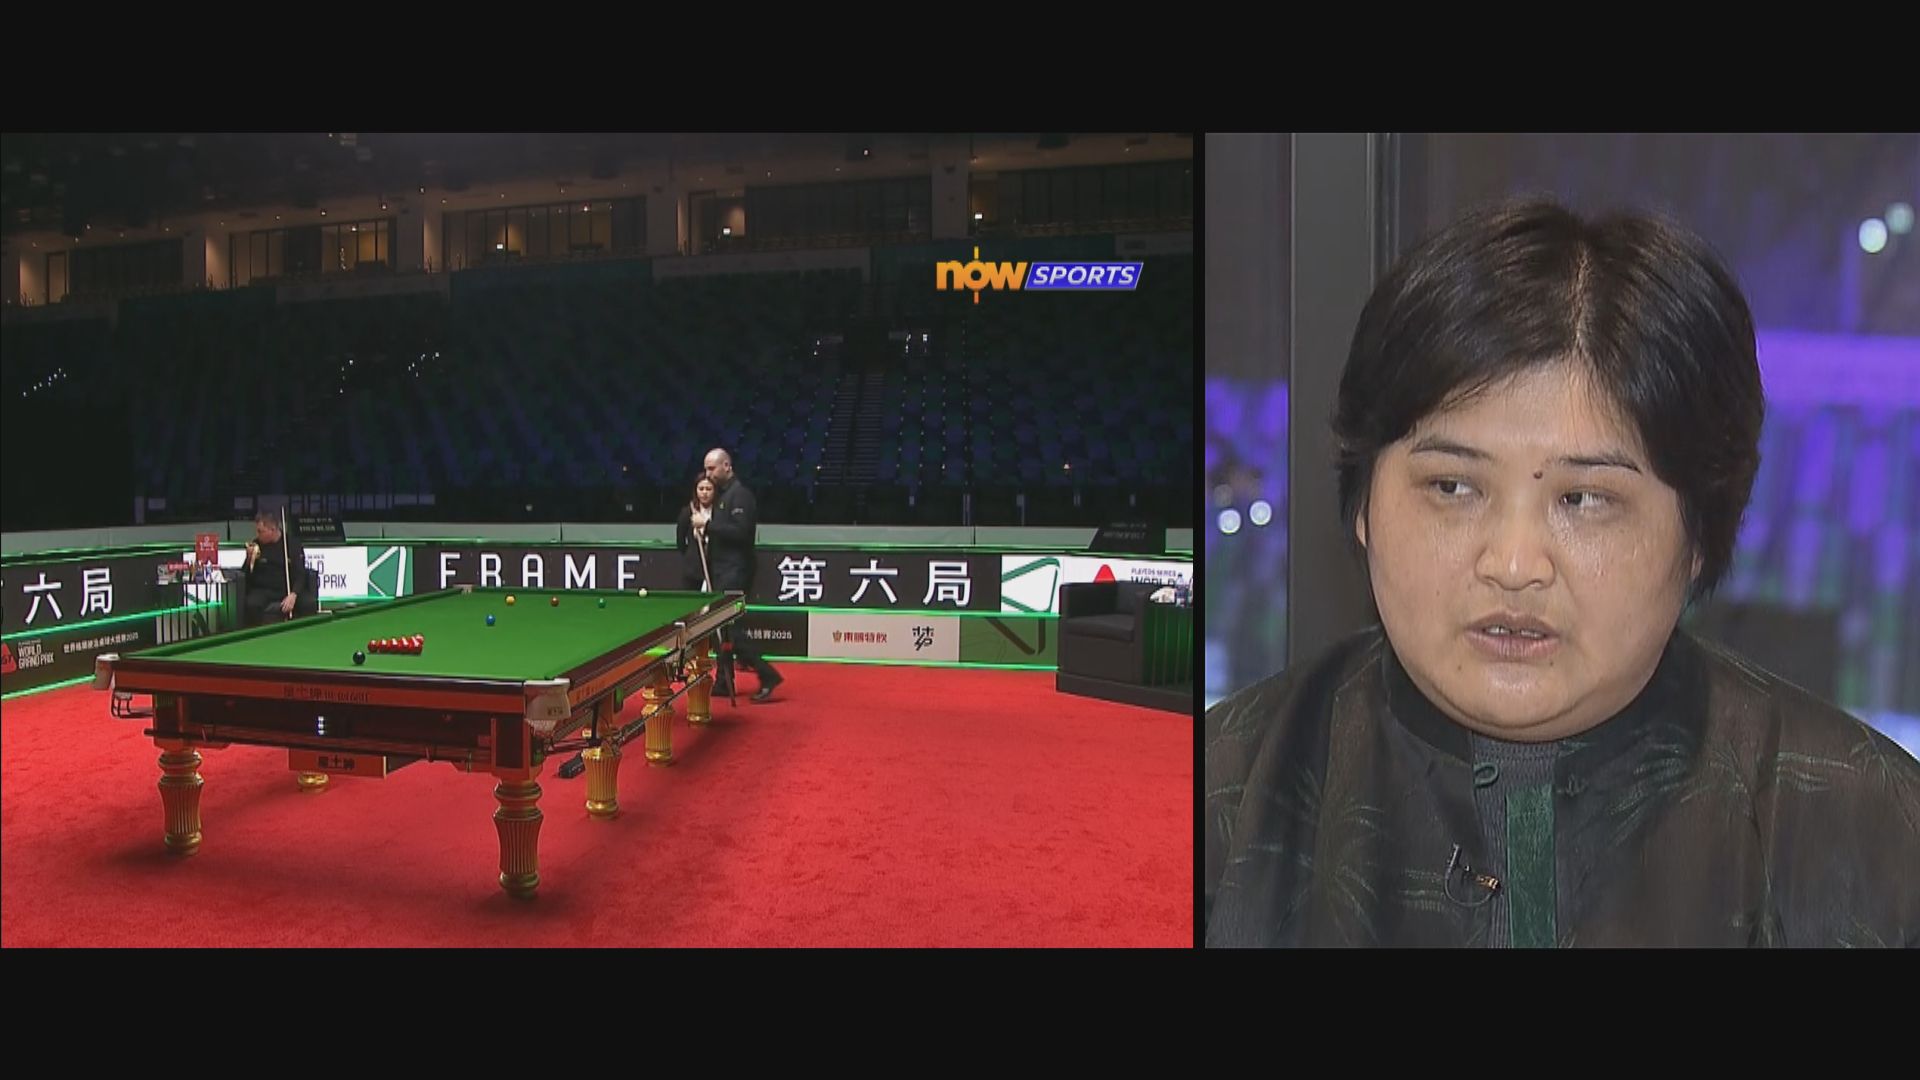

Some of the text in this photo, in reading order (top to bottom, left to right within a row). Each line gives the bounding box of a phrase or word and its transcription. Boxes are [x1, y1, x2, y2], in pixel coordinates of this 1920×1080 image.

[323, 573, 347, 590] PRIX
[439, 552, 640, 590] FRAME
[777, 555, 972, 608] 第六局
[1, 567, 114, 625] 六局
[18, 643, 42, 658] WORLD
